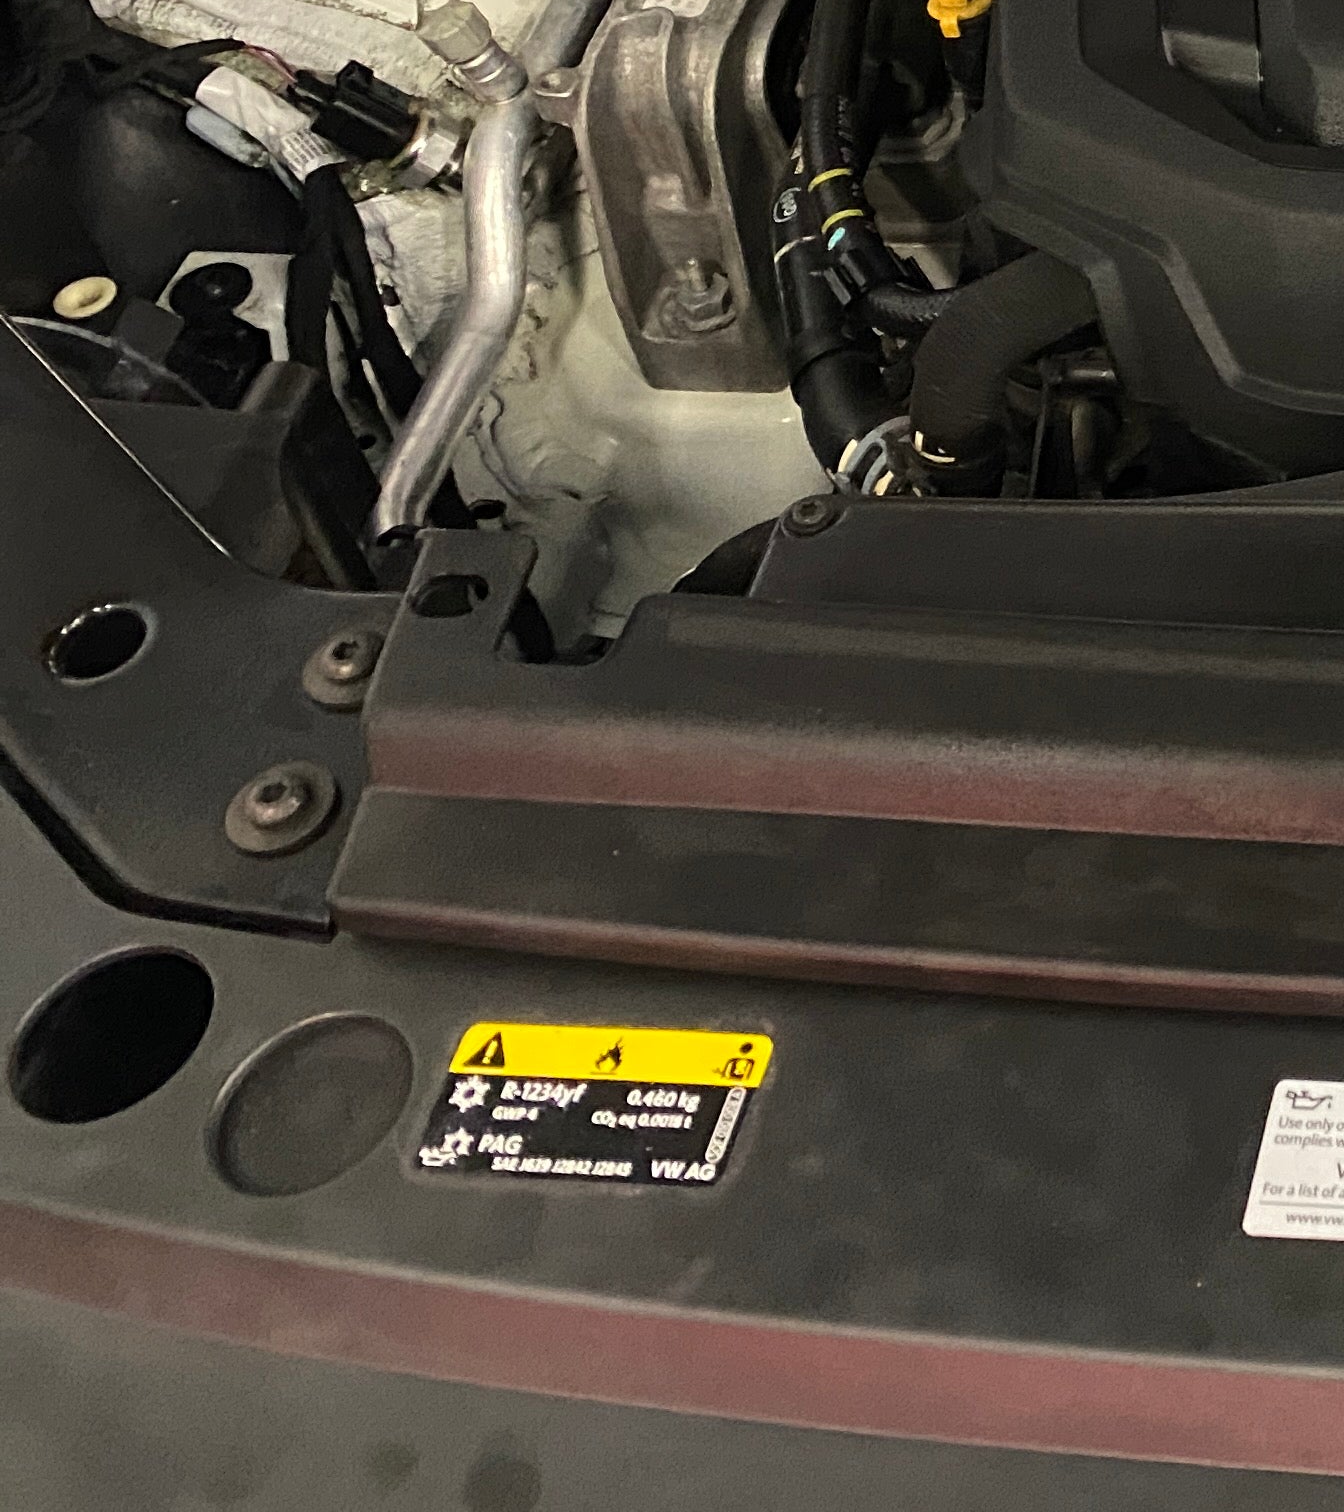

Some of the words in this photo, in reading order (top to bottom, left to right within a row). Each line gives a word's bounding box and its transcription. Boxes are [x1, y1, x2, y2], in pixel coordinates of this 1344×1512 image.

[1278, 1116, 1303, 1128] Use
[1305, 1117, 1334, 1134] only
[477, 1133, 522, 1154] PAG
[1273, 1133, 1332, 1149] complies
[651, 1159, 685, 1180] VW
[683, 1162, 716, 1181] AG
[1262, 1181, 1284, 1195] For
[1286, 1186, 1295, 1195] a
[1298, 1183, 1319, 1197] list
[1321, 1184, 1337, 1198] of
